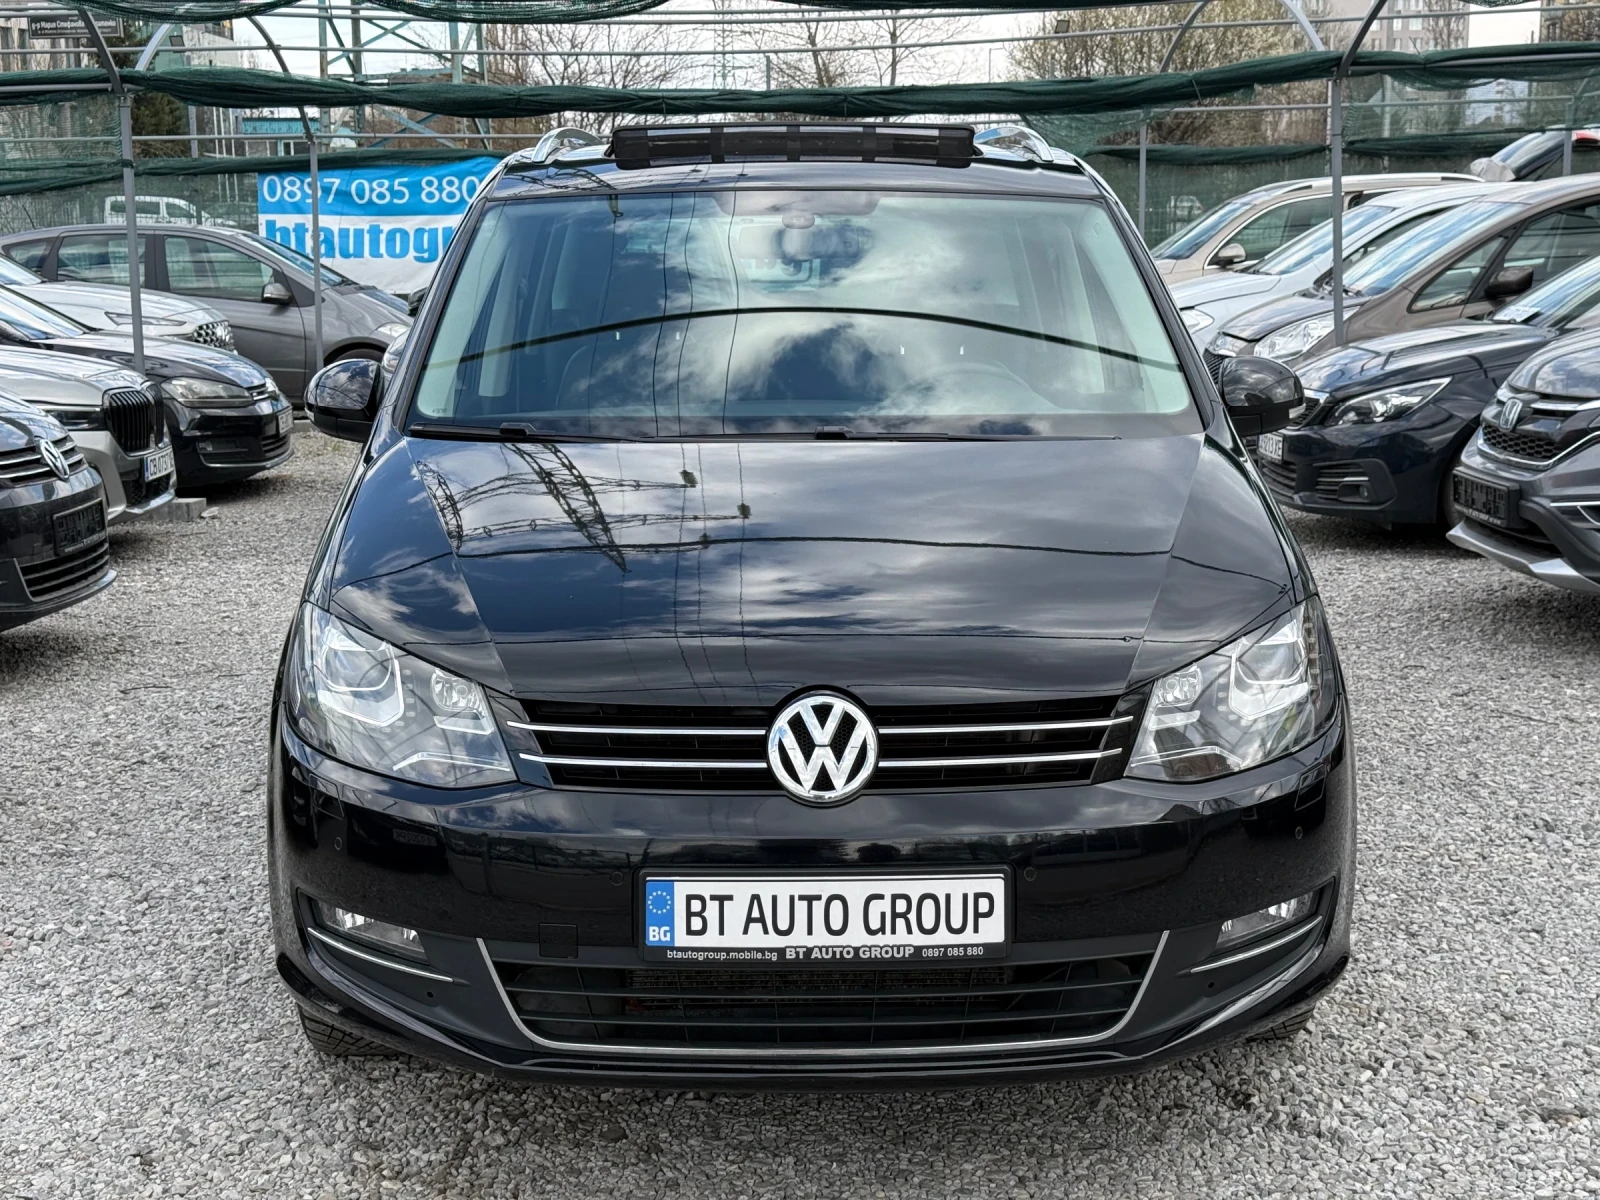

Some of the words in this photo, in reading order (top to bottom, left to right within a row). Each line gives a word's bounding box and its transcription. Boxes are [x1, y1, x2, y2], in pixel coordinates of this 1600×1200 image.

[263, 175, 341, 204] 0897
[350, 178, 410, 205] 085
[420, 175, 480, 204] 880
[685, 893, 734, 937] BT
[742, 893, 849, 937] AUTO
[863, 891, 995, 937] GROUP
[648, 926, 671, 942] BG
[666, 949, 778, 961] btautogroup.mobile.bg
[785, 947, 807, 959] BT
[811, 947, 855, 959] AUTO
[859, 946, 915, 959] GROUP
[922, 948, 945, 957] 0897
[947, 947, 964, 956] 085
[966, 946, 984, 955] 880
